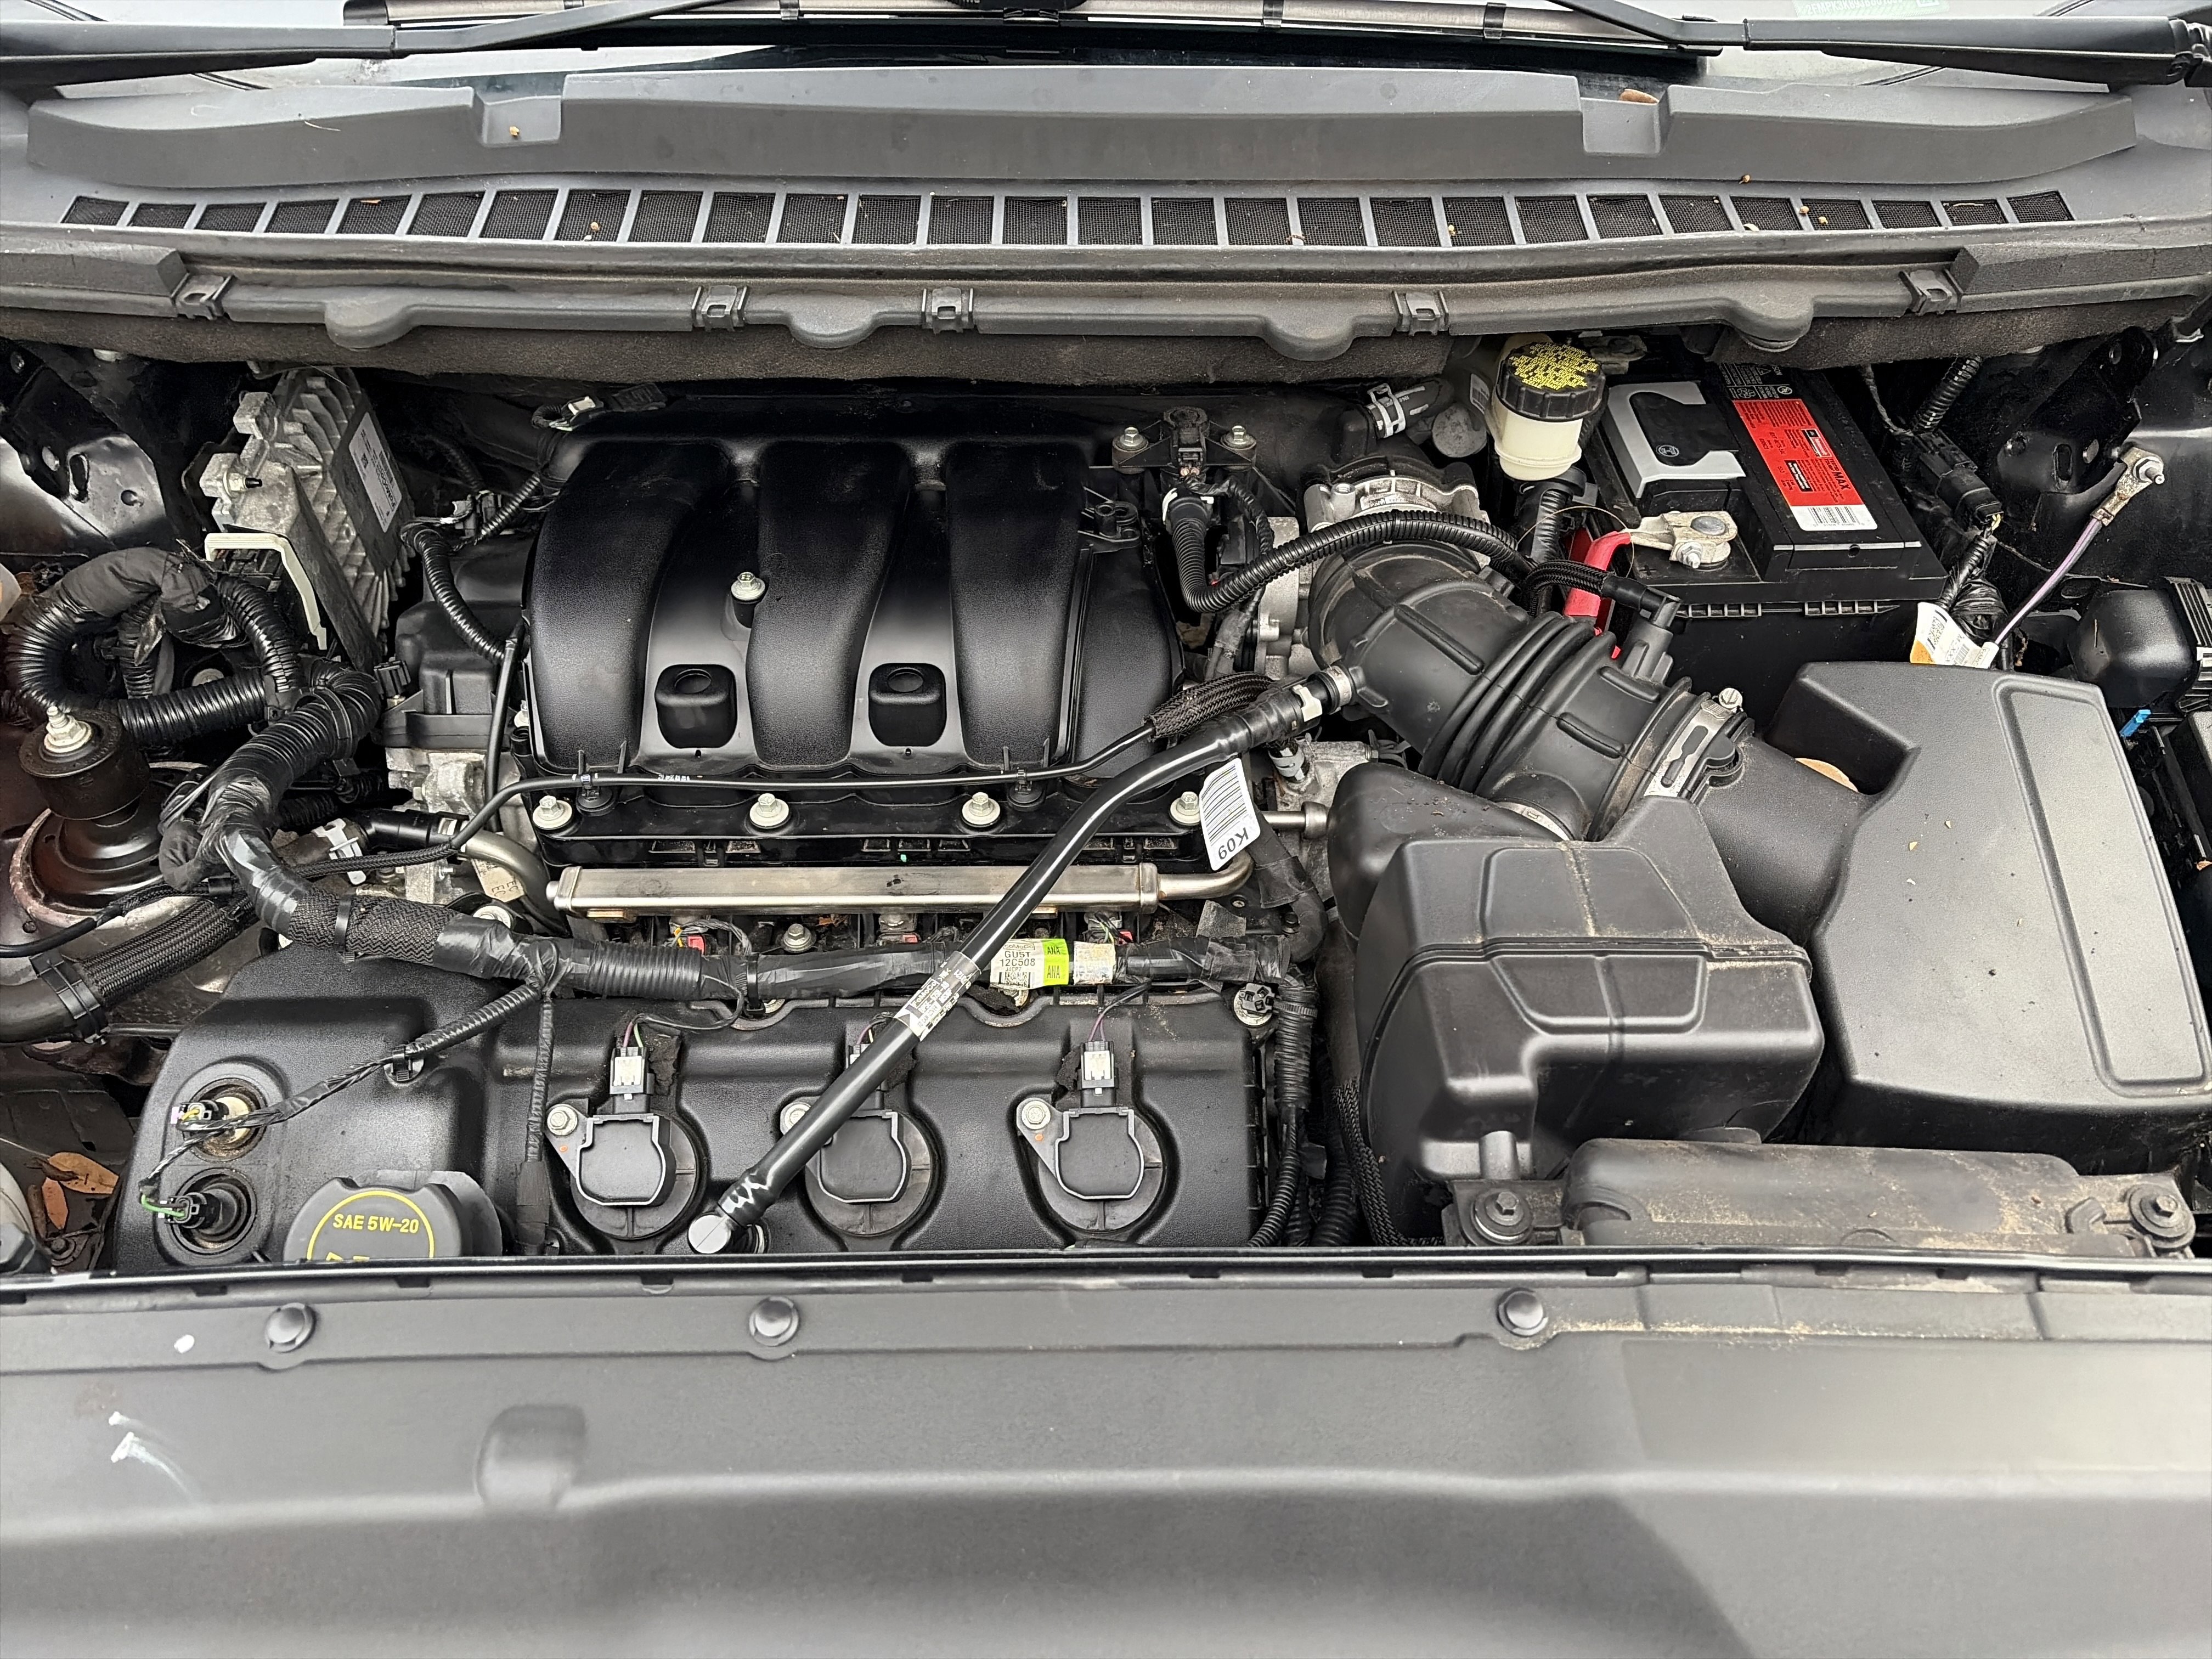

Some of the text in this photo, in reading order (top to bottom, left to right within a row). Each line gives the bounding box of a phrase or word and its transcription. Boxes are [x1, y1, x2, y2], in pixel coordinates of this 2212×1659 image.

[1831, 472, 1851, 490] MAX
[381, 472, 396, 507] FoMoCo
[1218, 827, 1249, 860] K09
[492, 885, 506, 897] EC
[506, 880, 518, 891] EC
[1047, 946, 1060, 955] ANA
[1000, 958, 1036, 967] 12C508
[1047, 965, 1060, 979] ANA
[912, 981, 937, 1007] FoMoCo
[332, 1214, 419, 1233] SAE 5W-20
